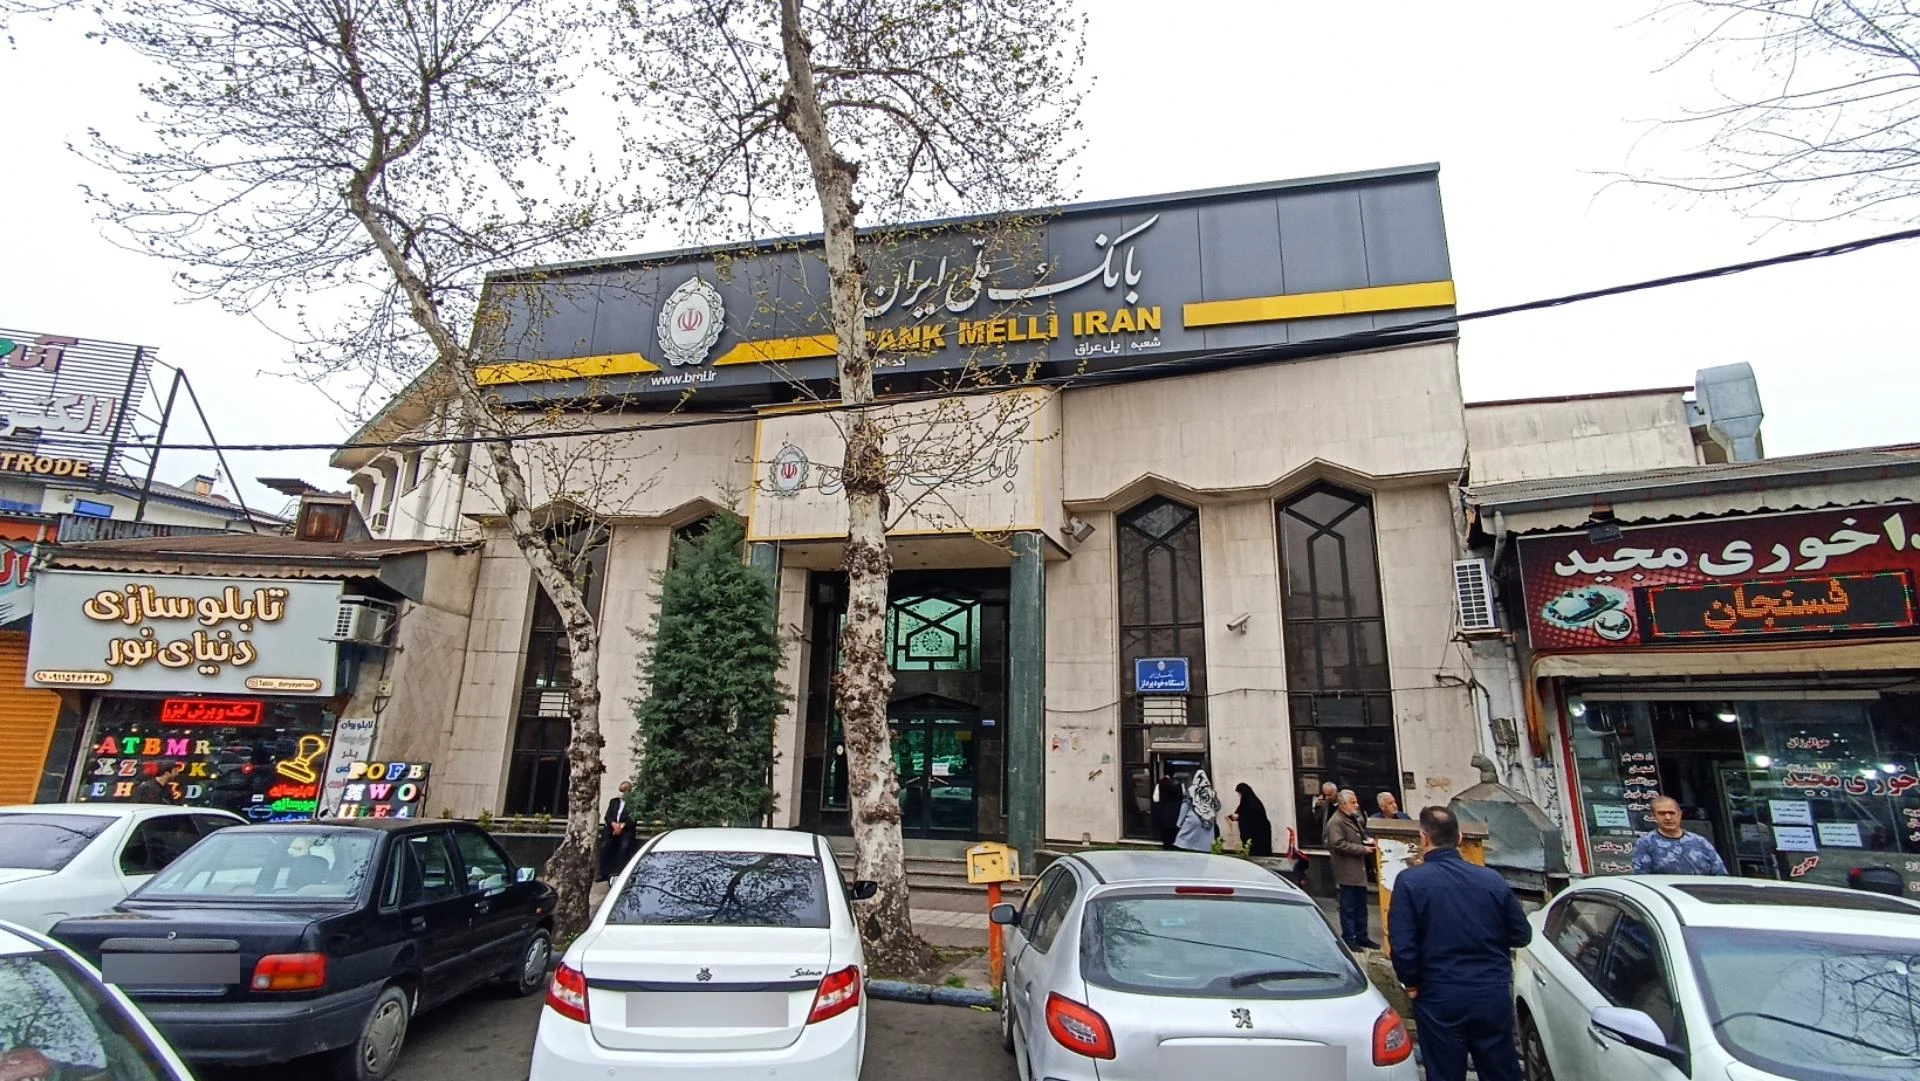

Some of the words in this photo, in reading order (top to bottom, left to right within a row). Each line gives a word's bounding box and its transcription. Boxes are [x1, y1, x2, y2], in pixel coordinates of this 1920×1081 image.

[987, 213, 1160, 305] بانک
[958, 313, 1059, 346] MELLI
[1073, 305, 1161, 336] IRAN
[1130, 335, 1161, 351] شعبه
[1074, 341, 1102, 356] عراق
[1102, 339, 1120, 354] پل
[650, 370, 717, 386] www.bml.ir
[1554, 547, 1689, 583] مجید
[1704, 577, 1850, 630] فسنجان
[105, 627, 156, 667] نور
[157, 630, 256, 676] دنیای
[1783, 770, 1841, 797] مجید
